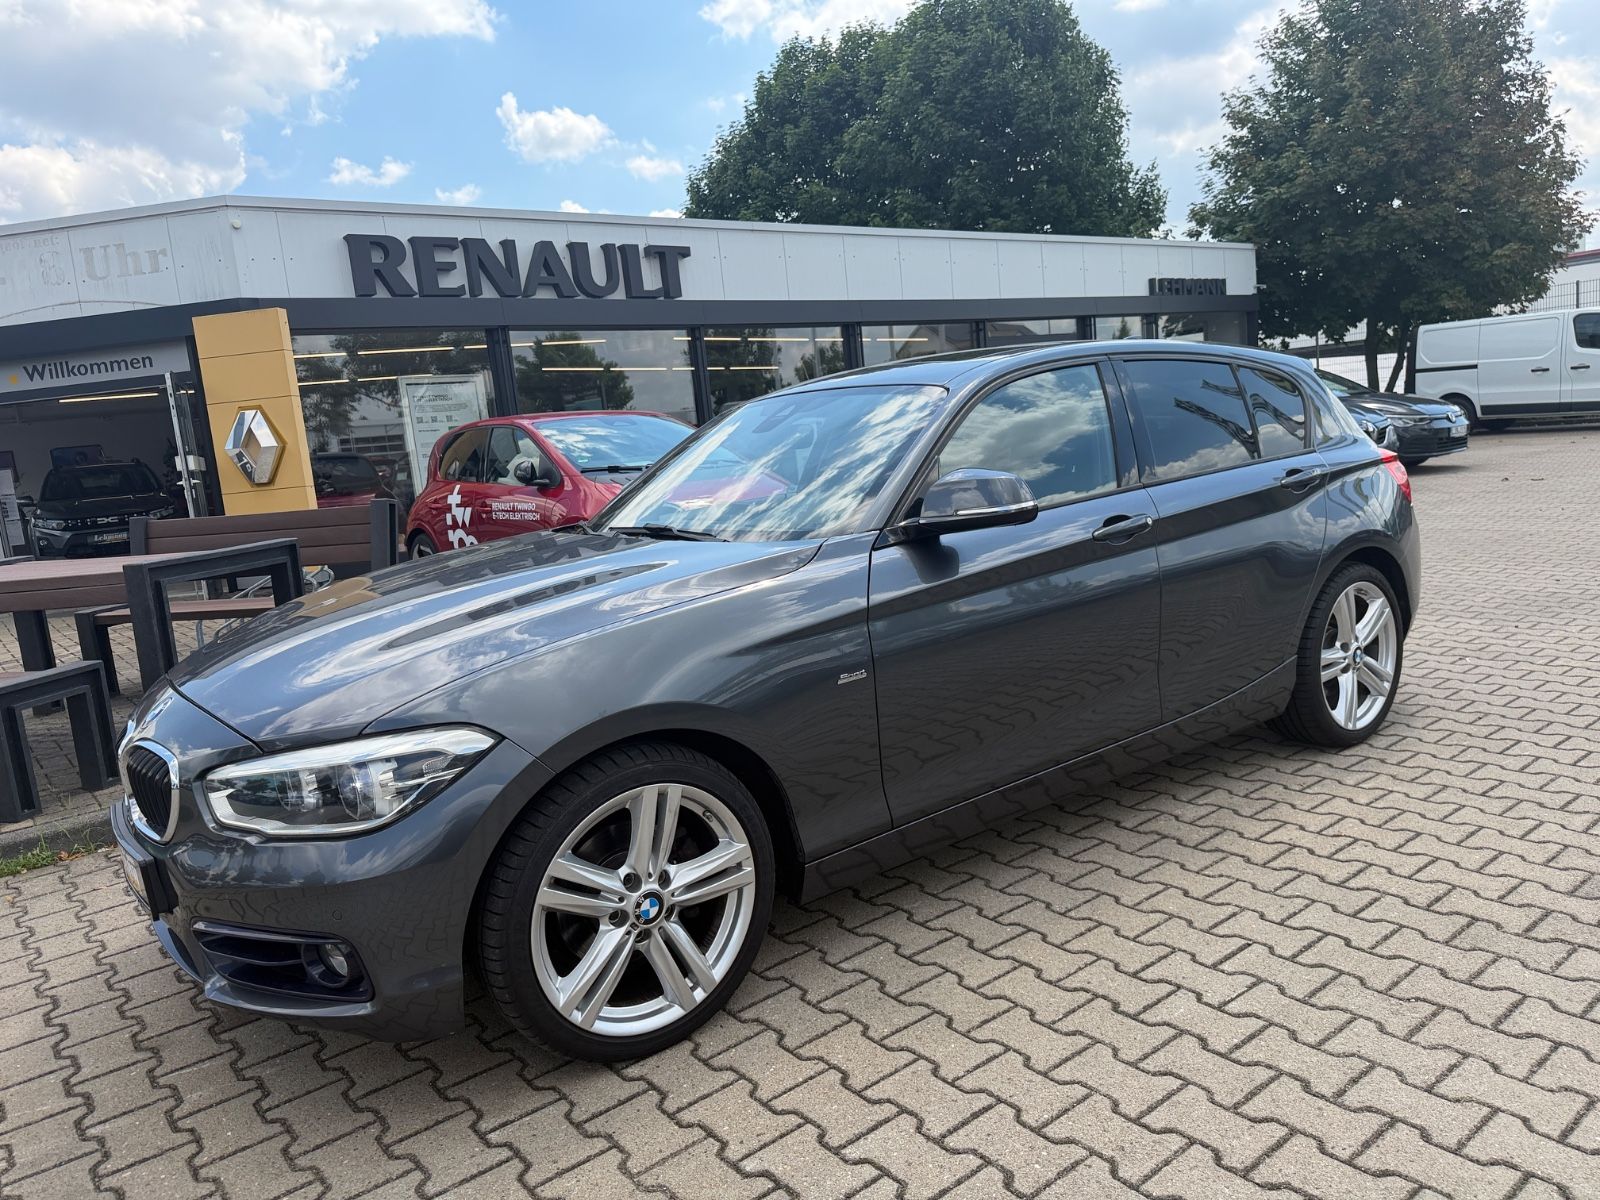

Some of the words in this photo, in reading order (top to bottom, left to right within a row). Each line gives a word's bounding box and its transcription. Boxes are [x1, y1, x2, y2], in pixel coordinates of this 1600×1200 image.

[79, 242, 168, 282] Uhr
[343, 233, 691, 300] RENAULT
[1148, 277, 1227, 297] LEHMANN
[22, 353, 154, 383] Willkommen
[491, 502, 514, 511] RENAULT
[514, 502, 536, 512] TWINGO
[492, 511, 509, 520] E-TECH
[509, 511, 541, 521] ELEKTRISCH
